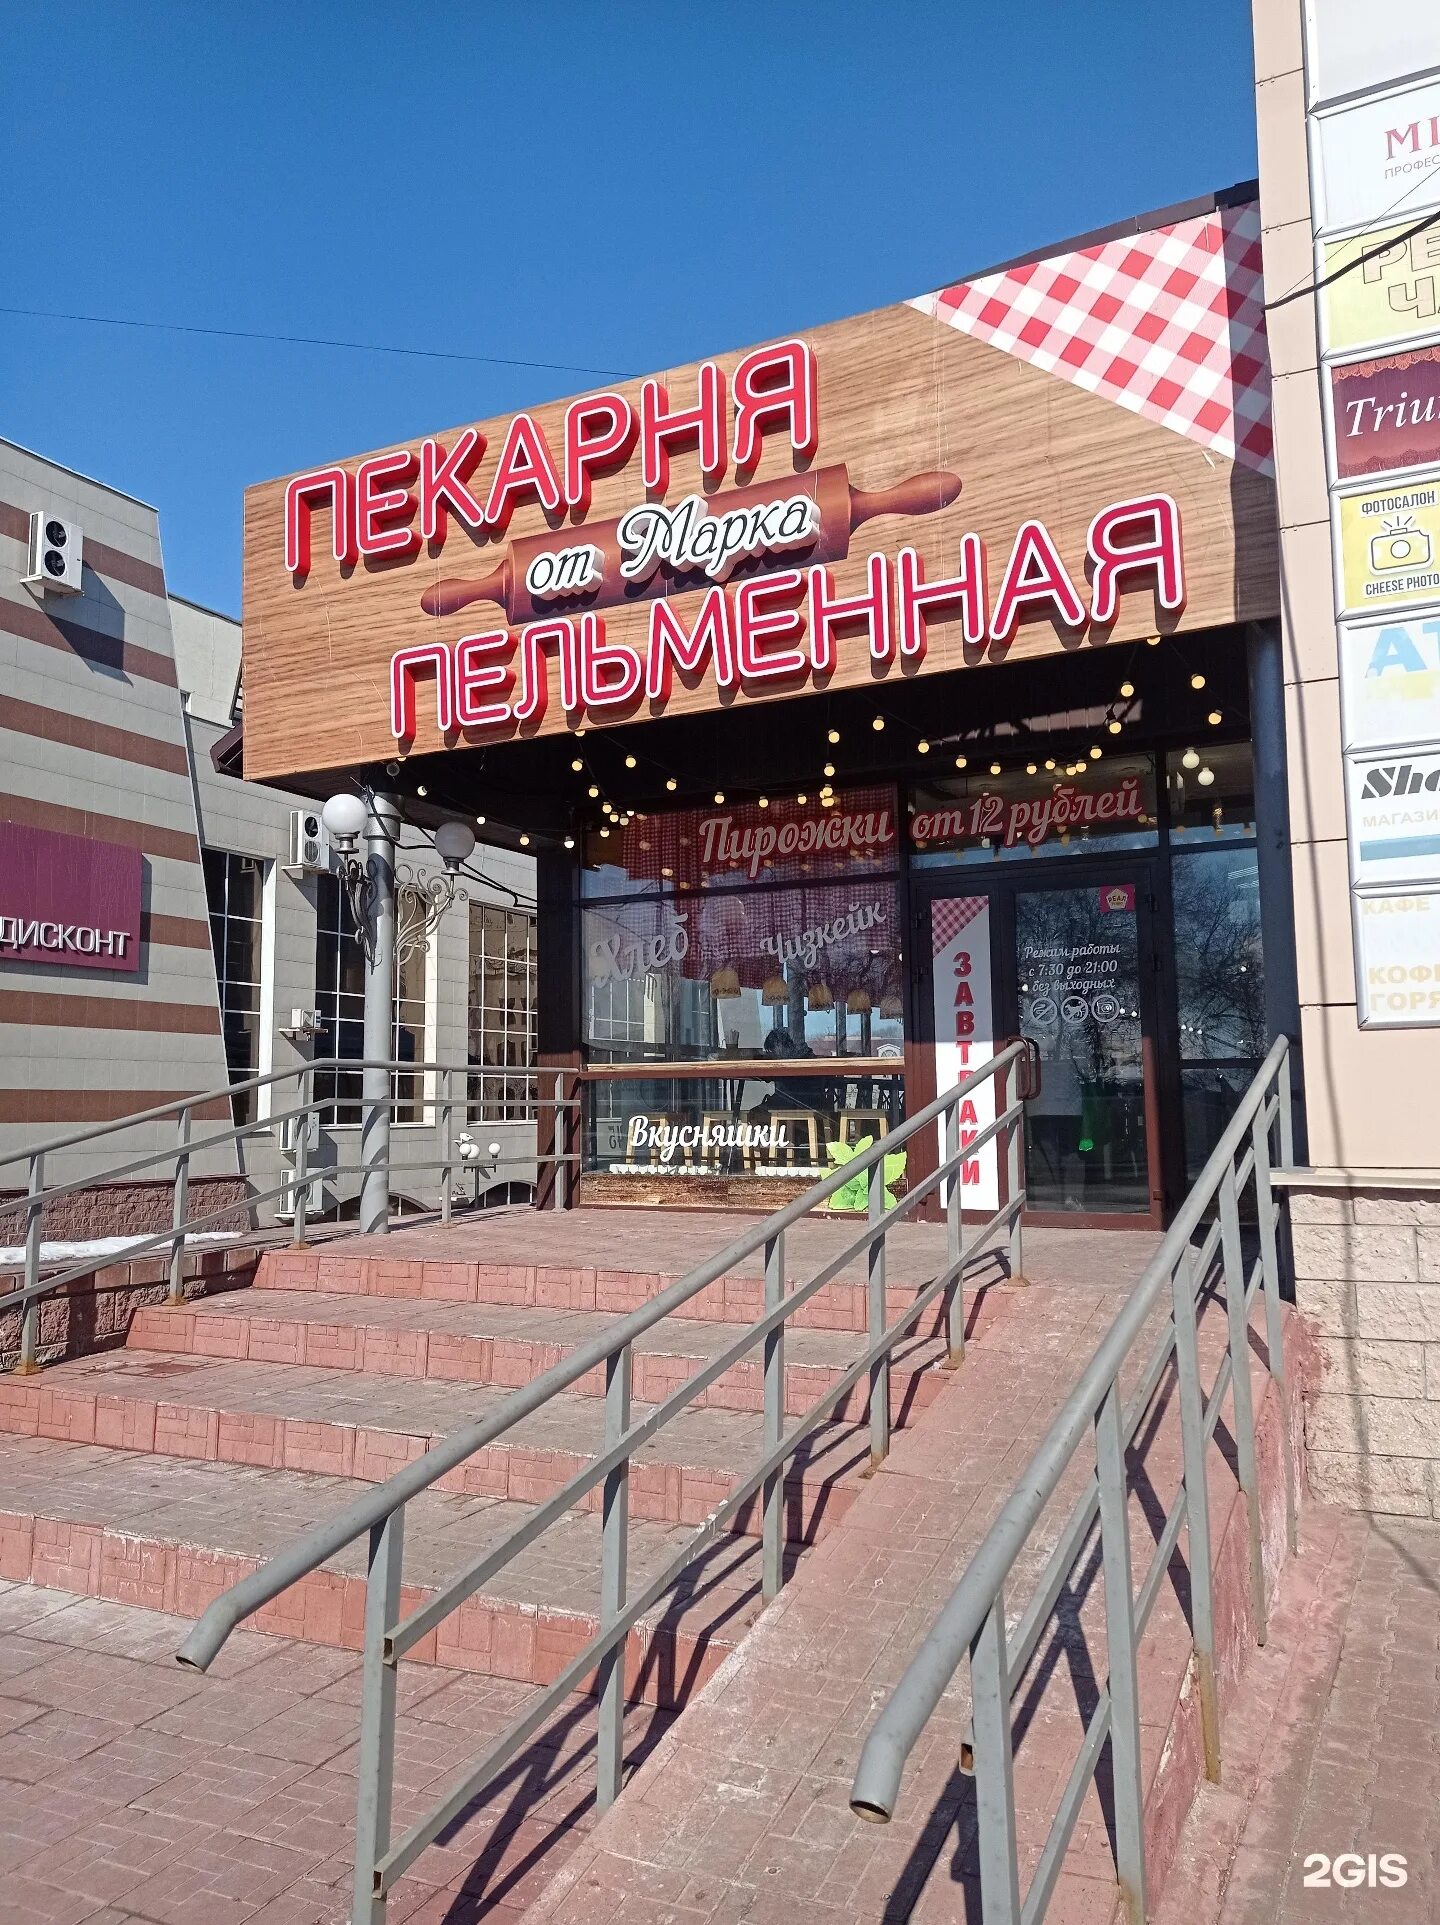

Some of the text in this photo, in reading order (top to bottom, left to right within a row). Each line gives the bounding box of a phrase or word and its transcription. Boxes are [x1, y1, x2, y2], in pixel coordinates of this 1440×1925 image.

[1388, 276, 1440, 318] Ч
[1346, 391, 1440, 437] Triu
[285, 338, 816, 576] ПЕКАРНЯ
[1362, 490, 1435, 514] ФОТОСАЛОН
[526, 494, 819, 596] от Марка
[1366, 573, 1440, 595] CHEESE PHOTO
[391, 493, 1187, 741] ПЕЛЬМЕННАЯ
[699, 779, 1143, 878] Пирожки от 12 рублей
[1363, 808, 1440, 827] МАГАЗИ
[1361, 896, 1431, 914] КАФЕ
[0, 916, 131, 956] ДИСКОНТ
[590, 912, 689, 988] Хлеб
[760, 902, 887, 969] Чизкейк
[1024, 943, 1120, 961] Режим работы
[1032, 978, 1116, 997] без выходных
[1038, 963, 1064, 976] 7:30
[1066, 965, 1082, 980] до
[1085, 960, 1118, 974] 21:00
[628, 1115, 790, 1163] Вкусняшки
